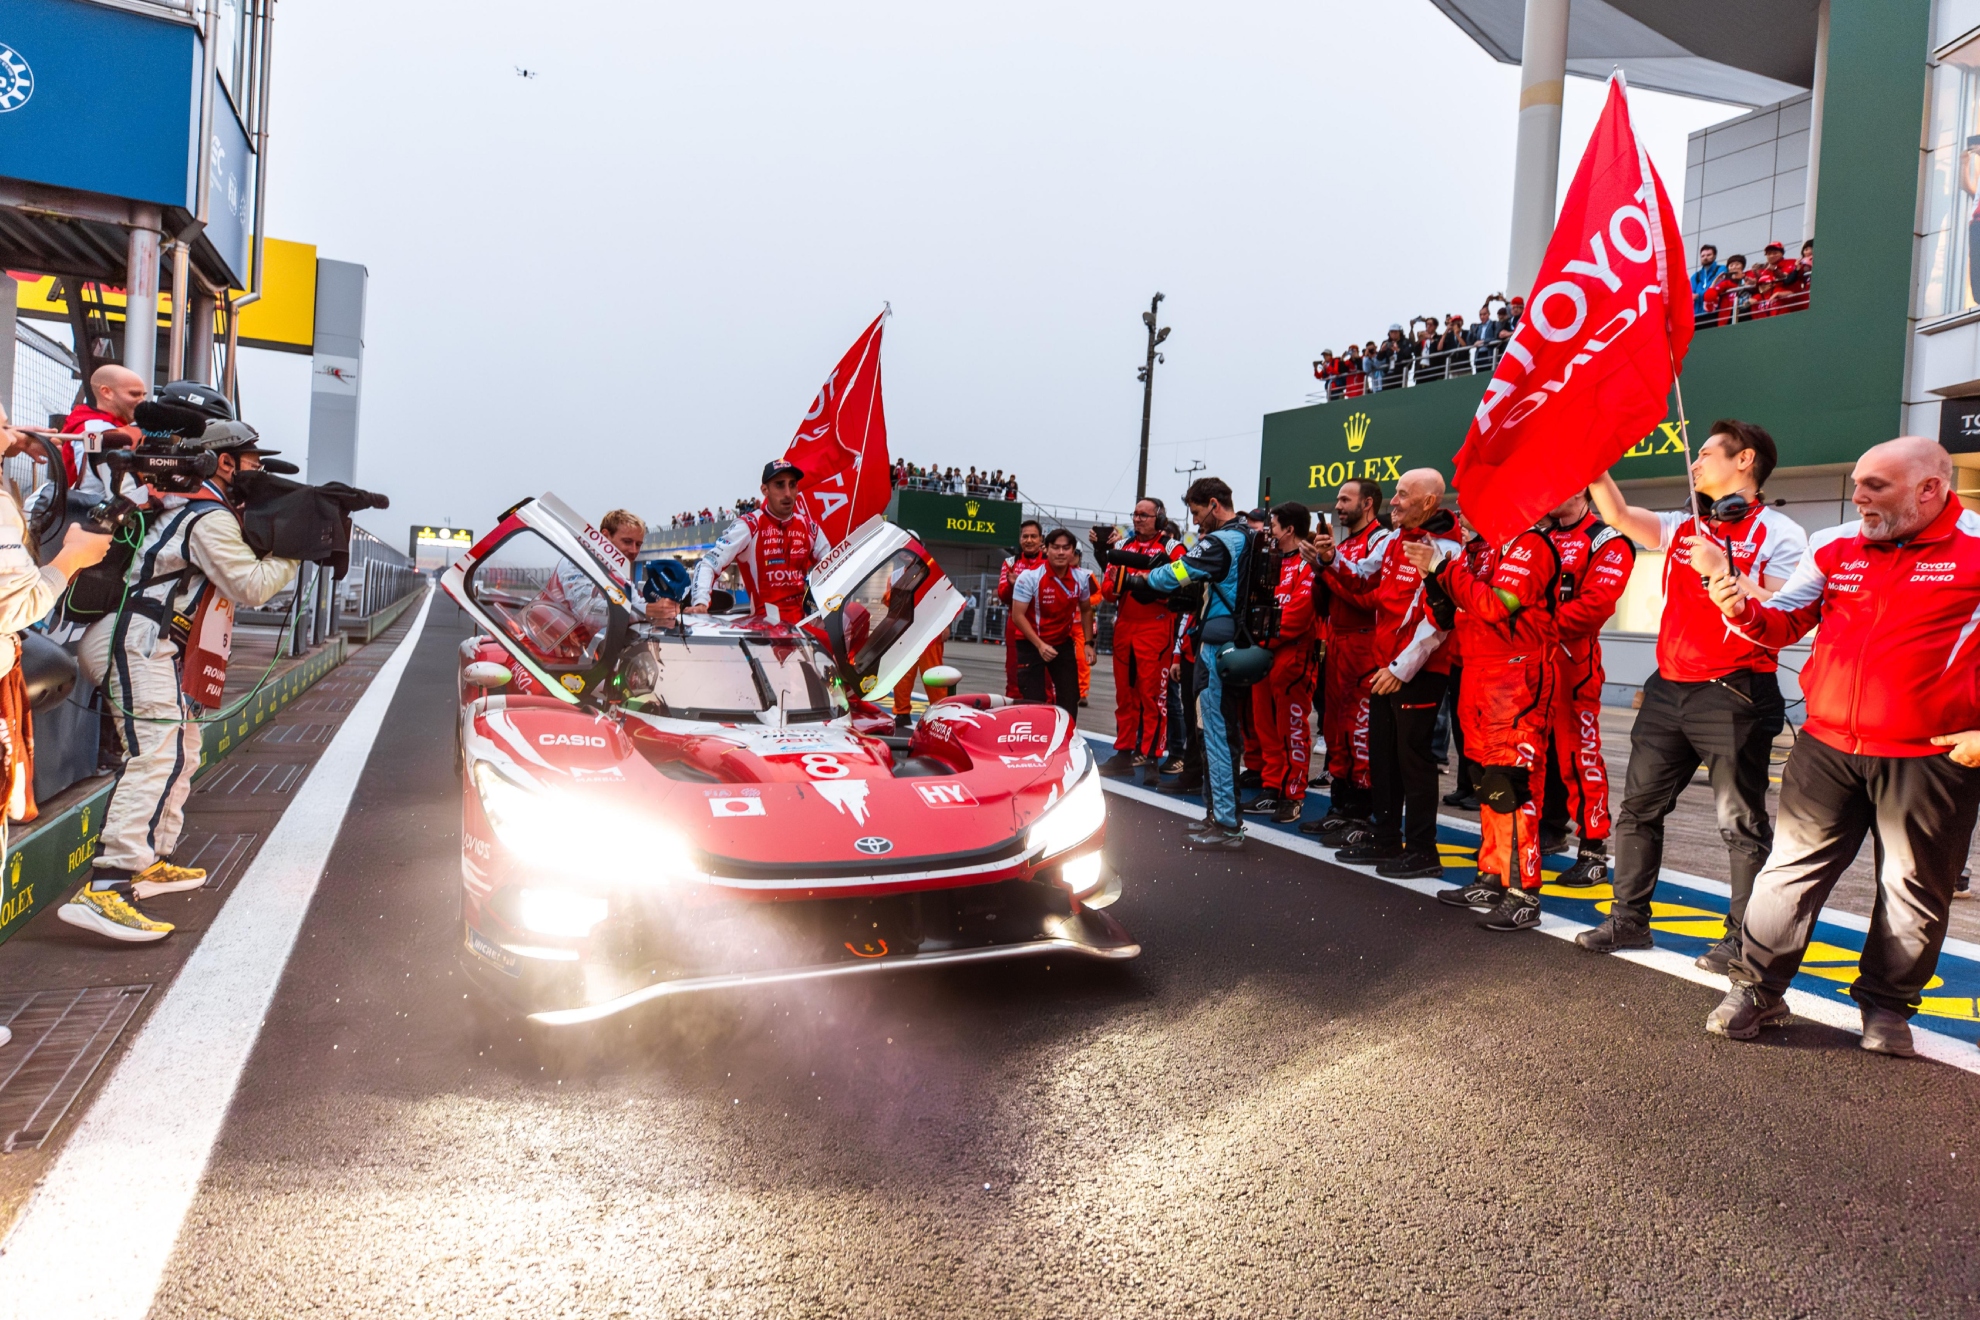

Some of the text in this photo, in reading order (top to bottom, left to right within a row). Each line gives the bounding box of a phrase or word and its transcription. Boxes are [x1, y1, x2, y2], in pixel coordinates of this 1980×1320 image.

[1308, 455, 1402, 488] ROLEX
[946, 518, 996, 534] ROLEX
[583, 523, 626, 568] TOYOTA
[814, 540, 851, 574] TOYOTA
[1909, 574, 1955, 582] DENSO
[1915, 562, 1957, 570] TOYOTA
[538, 733, 606, 748] CASIO
[997, 734, 1048, 743] EDIFICE
[1289, 702, 1306, 763] DENSO
[1353, 697, 1370, 761] DENSO
[1580, 710, 1603, 782] DENSO
[801, 753, 850, 779] 8
[918, 783, 965, 804] HY
[0, 883, 35, 929] OLEX
